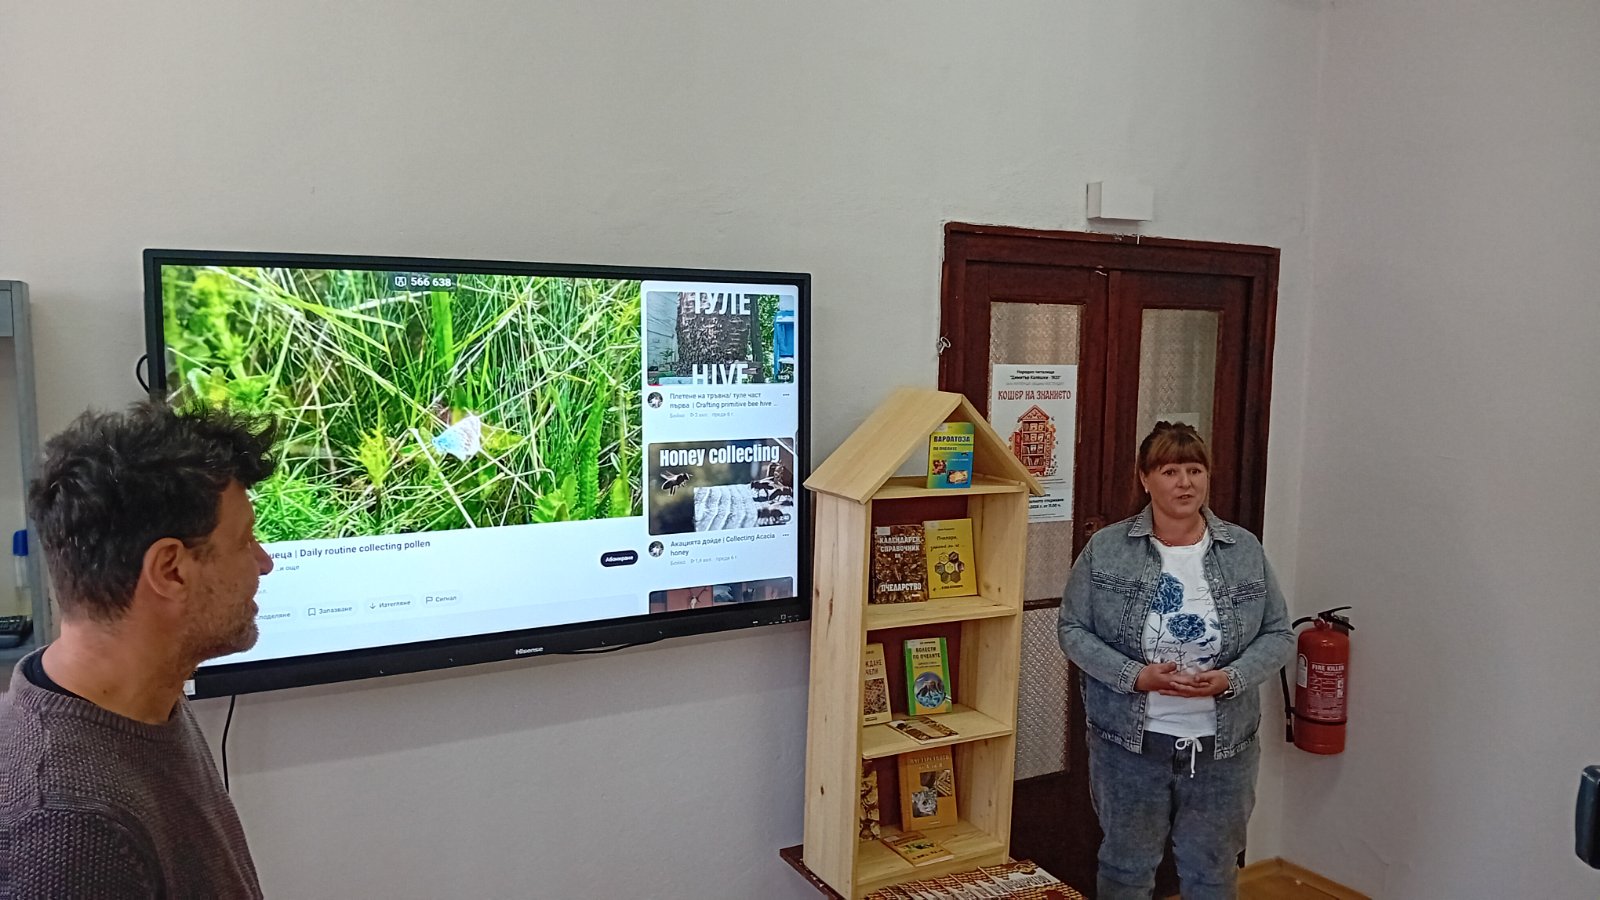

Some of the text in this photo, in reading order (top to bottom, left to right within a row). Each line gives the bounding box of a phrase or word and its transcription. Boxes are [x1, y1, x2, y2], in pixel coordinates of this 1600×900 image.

[410, 278, 452, 288] 566 638
[669, 392, 697, 400] Плетене
[732, 393, 747, 401] туле
[998, 390, 1072, 401] КОШЕР НА ЗНАНИЕТО
[669, 402, 690, 410] първа
[695, 401, 720, 410] Crafting
[720, 401, 747, 409] primitive
[747, 400, 759, 408] bee
[759, 400, 772, 408] hive
[933, 435, 971, 443] ВАРОАТОЗА
[659, 444, 780, 467] Honey collecting
[670, 539, 701, 548] Акацията
[701, 537, 722, 546] дойде
[725, 534, 755, 543] Collecting
[755, 533, 776, 541] Acacia
[300, 547, 324, 559] Daily
[324, 544, 357, 556] routine
[358, 541, 402, 554] collecting
[403, 539, 431, 552] pollen
[670, 548, 690, 558] honey
[880, 544, 921, 553] СПРАВОЧНИК
[881, 582, 922, 592] ПЧЕЛАРСТВО
[435, 594, 457, 603] Сигнал
[379, 600, 412, 609] Изтегляне
[318, 605, 353, 615] Запазване
[515, 647, 544, 655] Hisense
[920, 652, 941, 660] ПЧЕЛИТЕ
